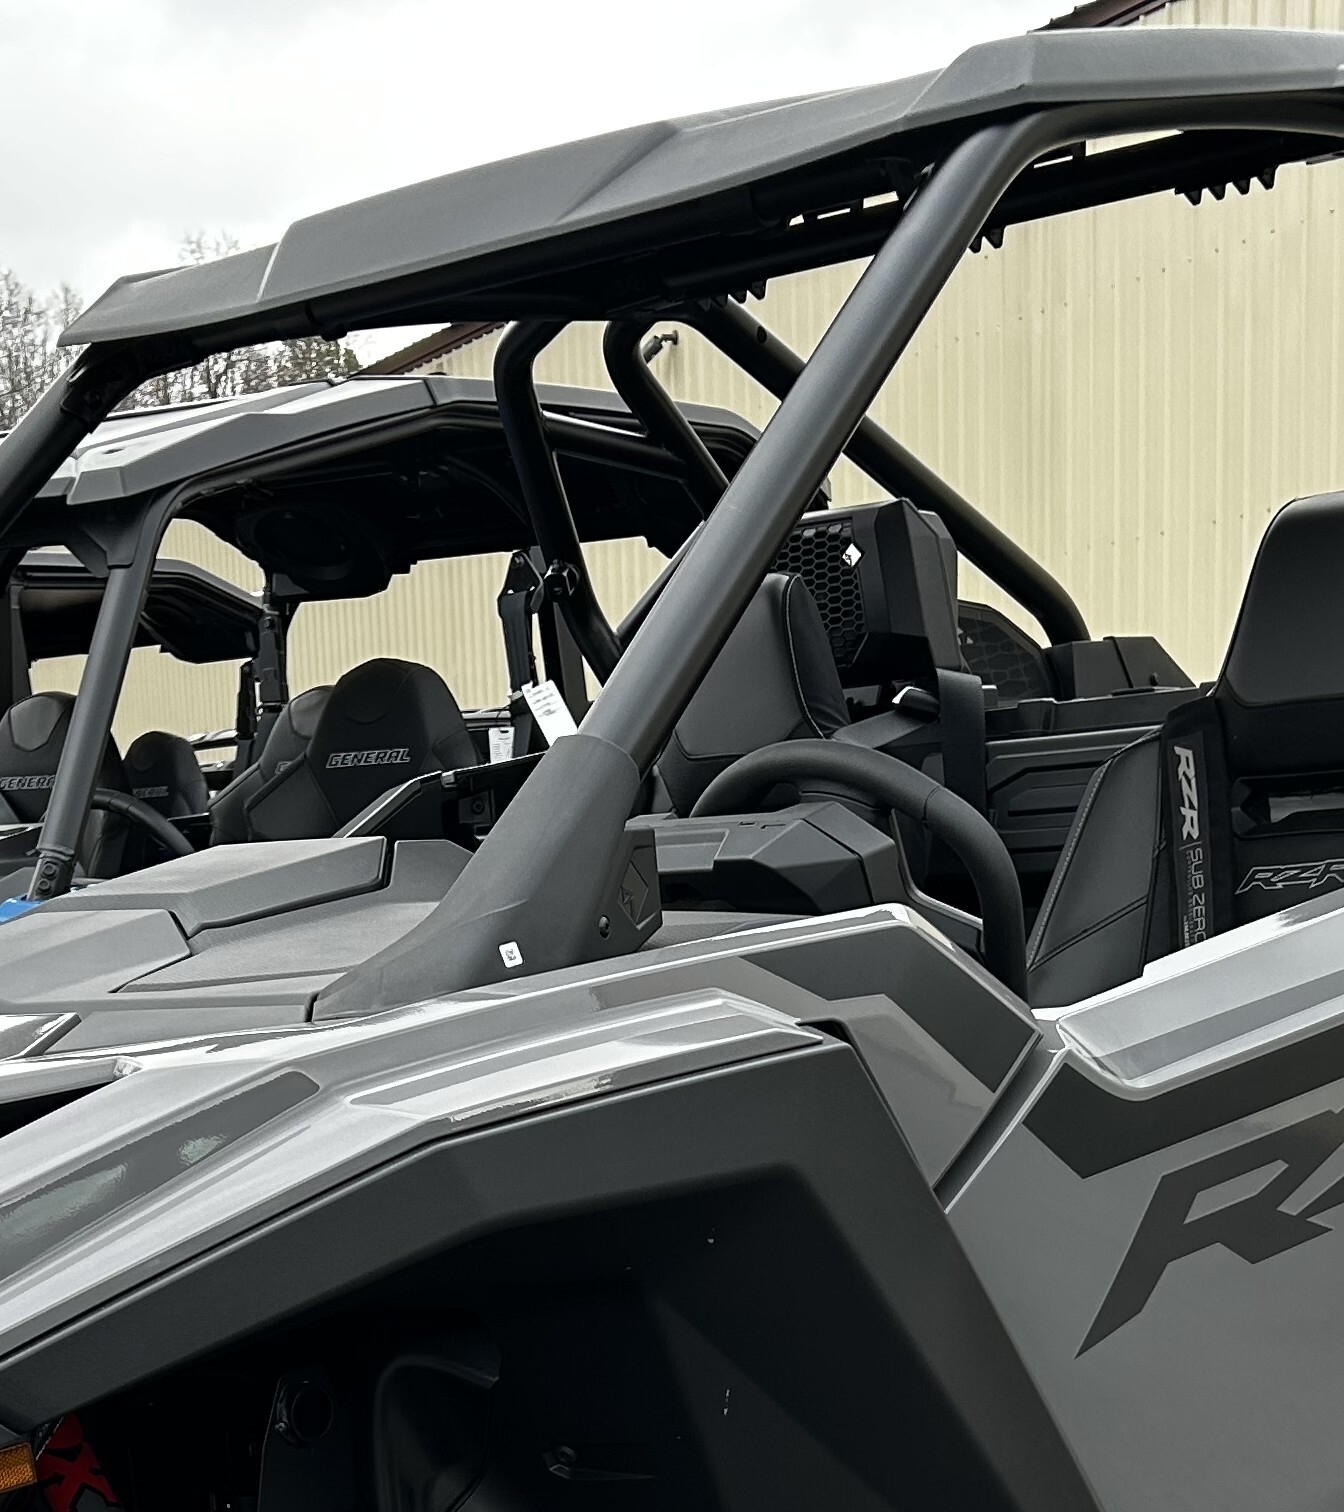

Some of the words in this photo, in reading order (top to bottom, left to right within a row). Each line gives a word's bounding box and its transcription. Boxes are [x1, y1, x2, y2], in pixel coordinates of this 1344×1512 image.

[326, 748, 411, 769] GENERAL
[1174, 746, 1200, 841] RZR
[1191, 847, 1204, 889] SUB
